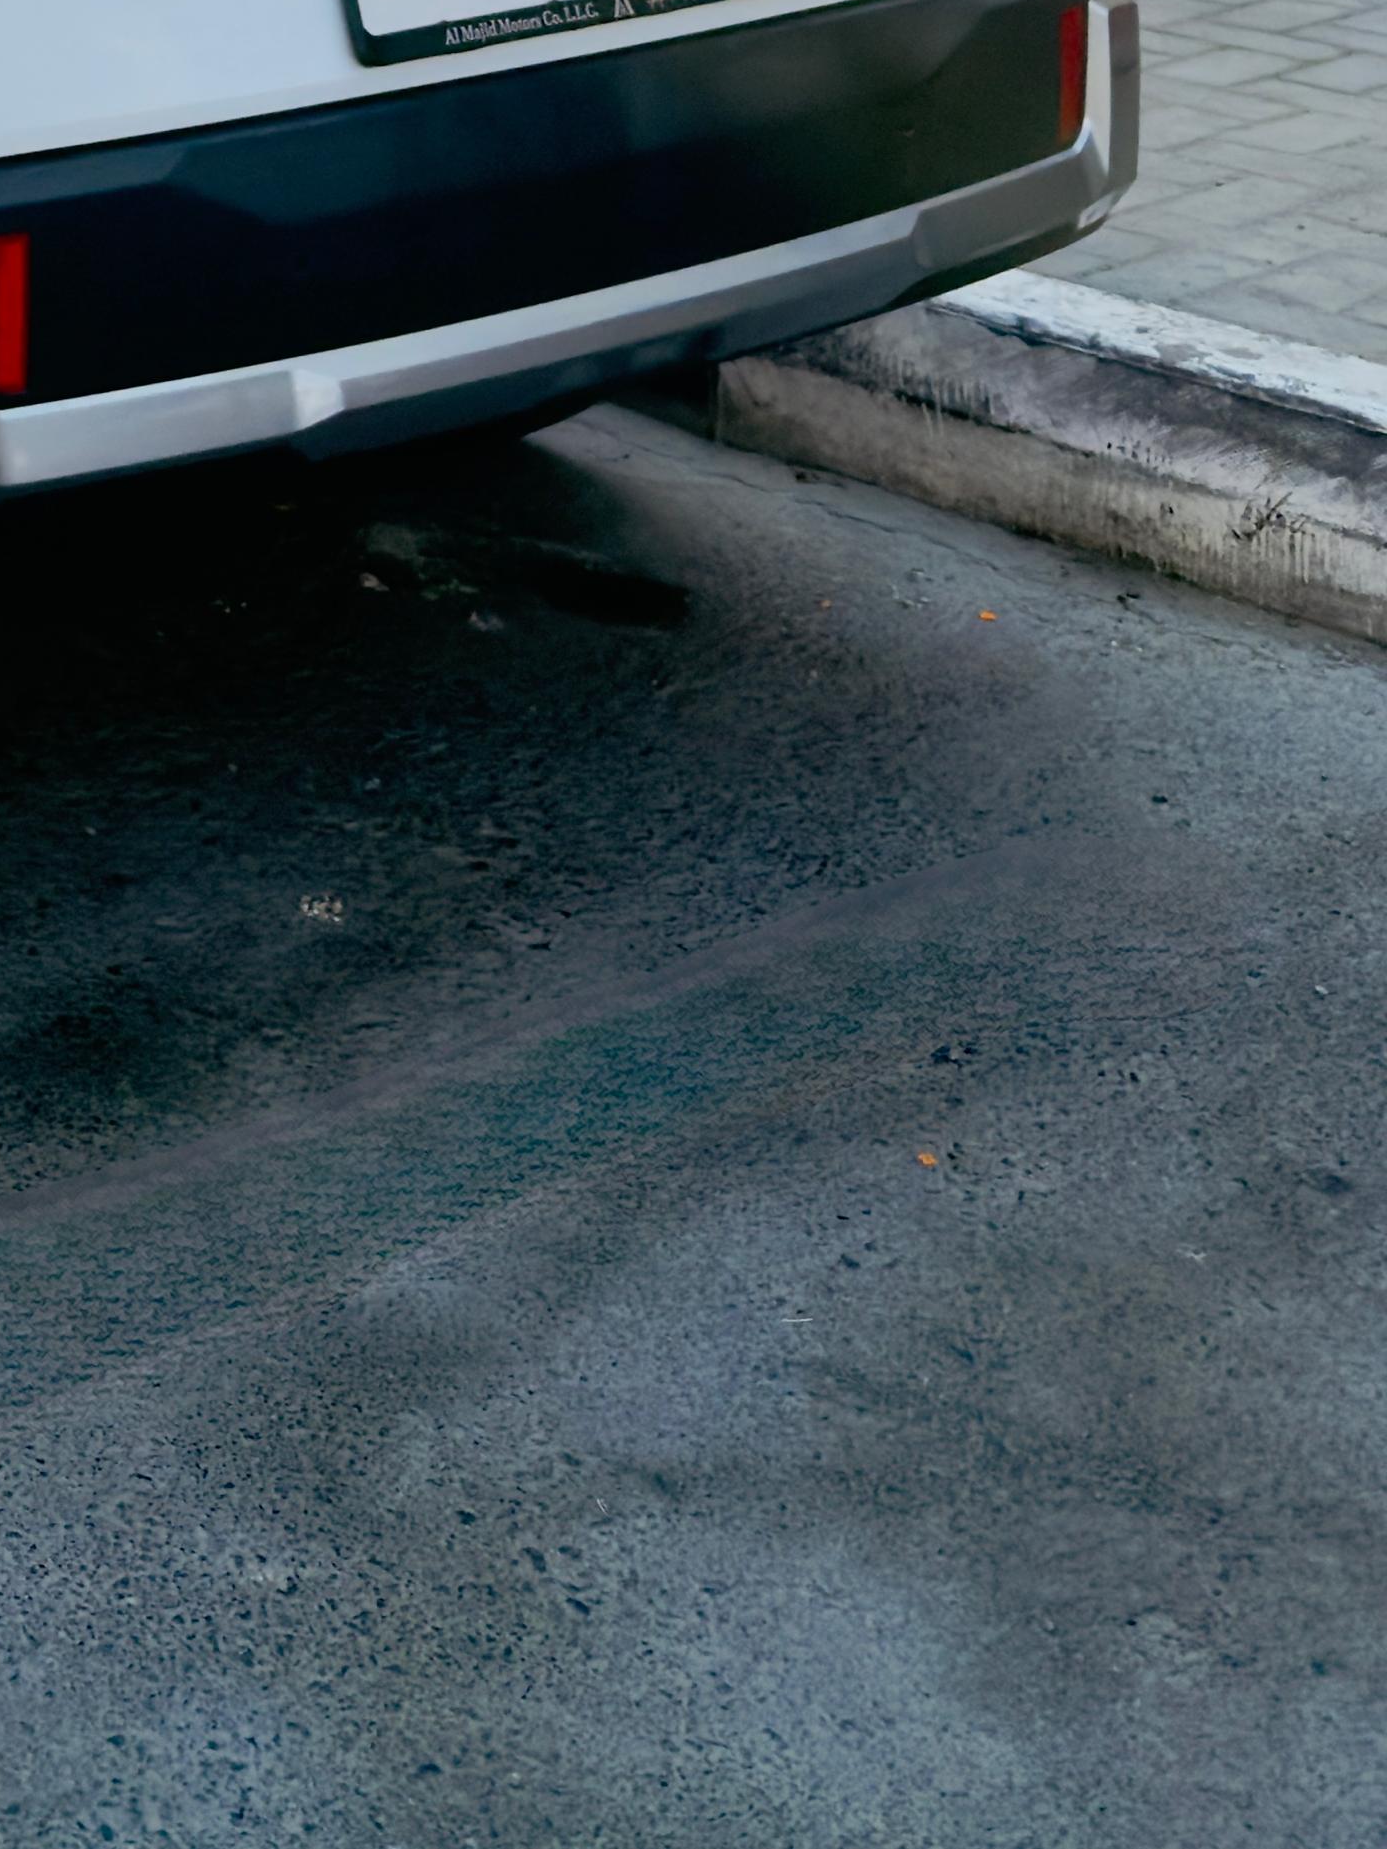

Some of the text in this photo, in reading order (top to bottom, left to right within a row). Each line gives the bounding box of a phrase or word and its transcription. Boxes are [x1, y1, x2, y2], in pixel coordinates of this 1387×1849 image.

[445, 28, 460, 46] Al
[460, 21, 496, 44] Majid
[497, 13, 542, 37] Motors
